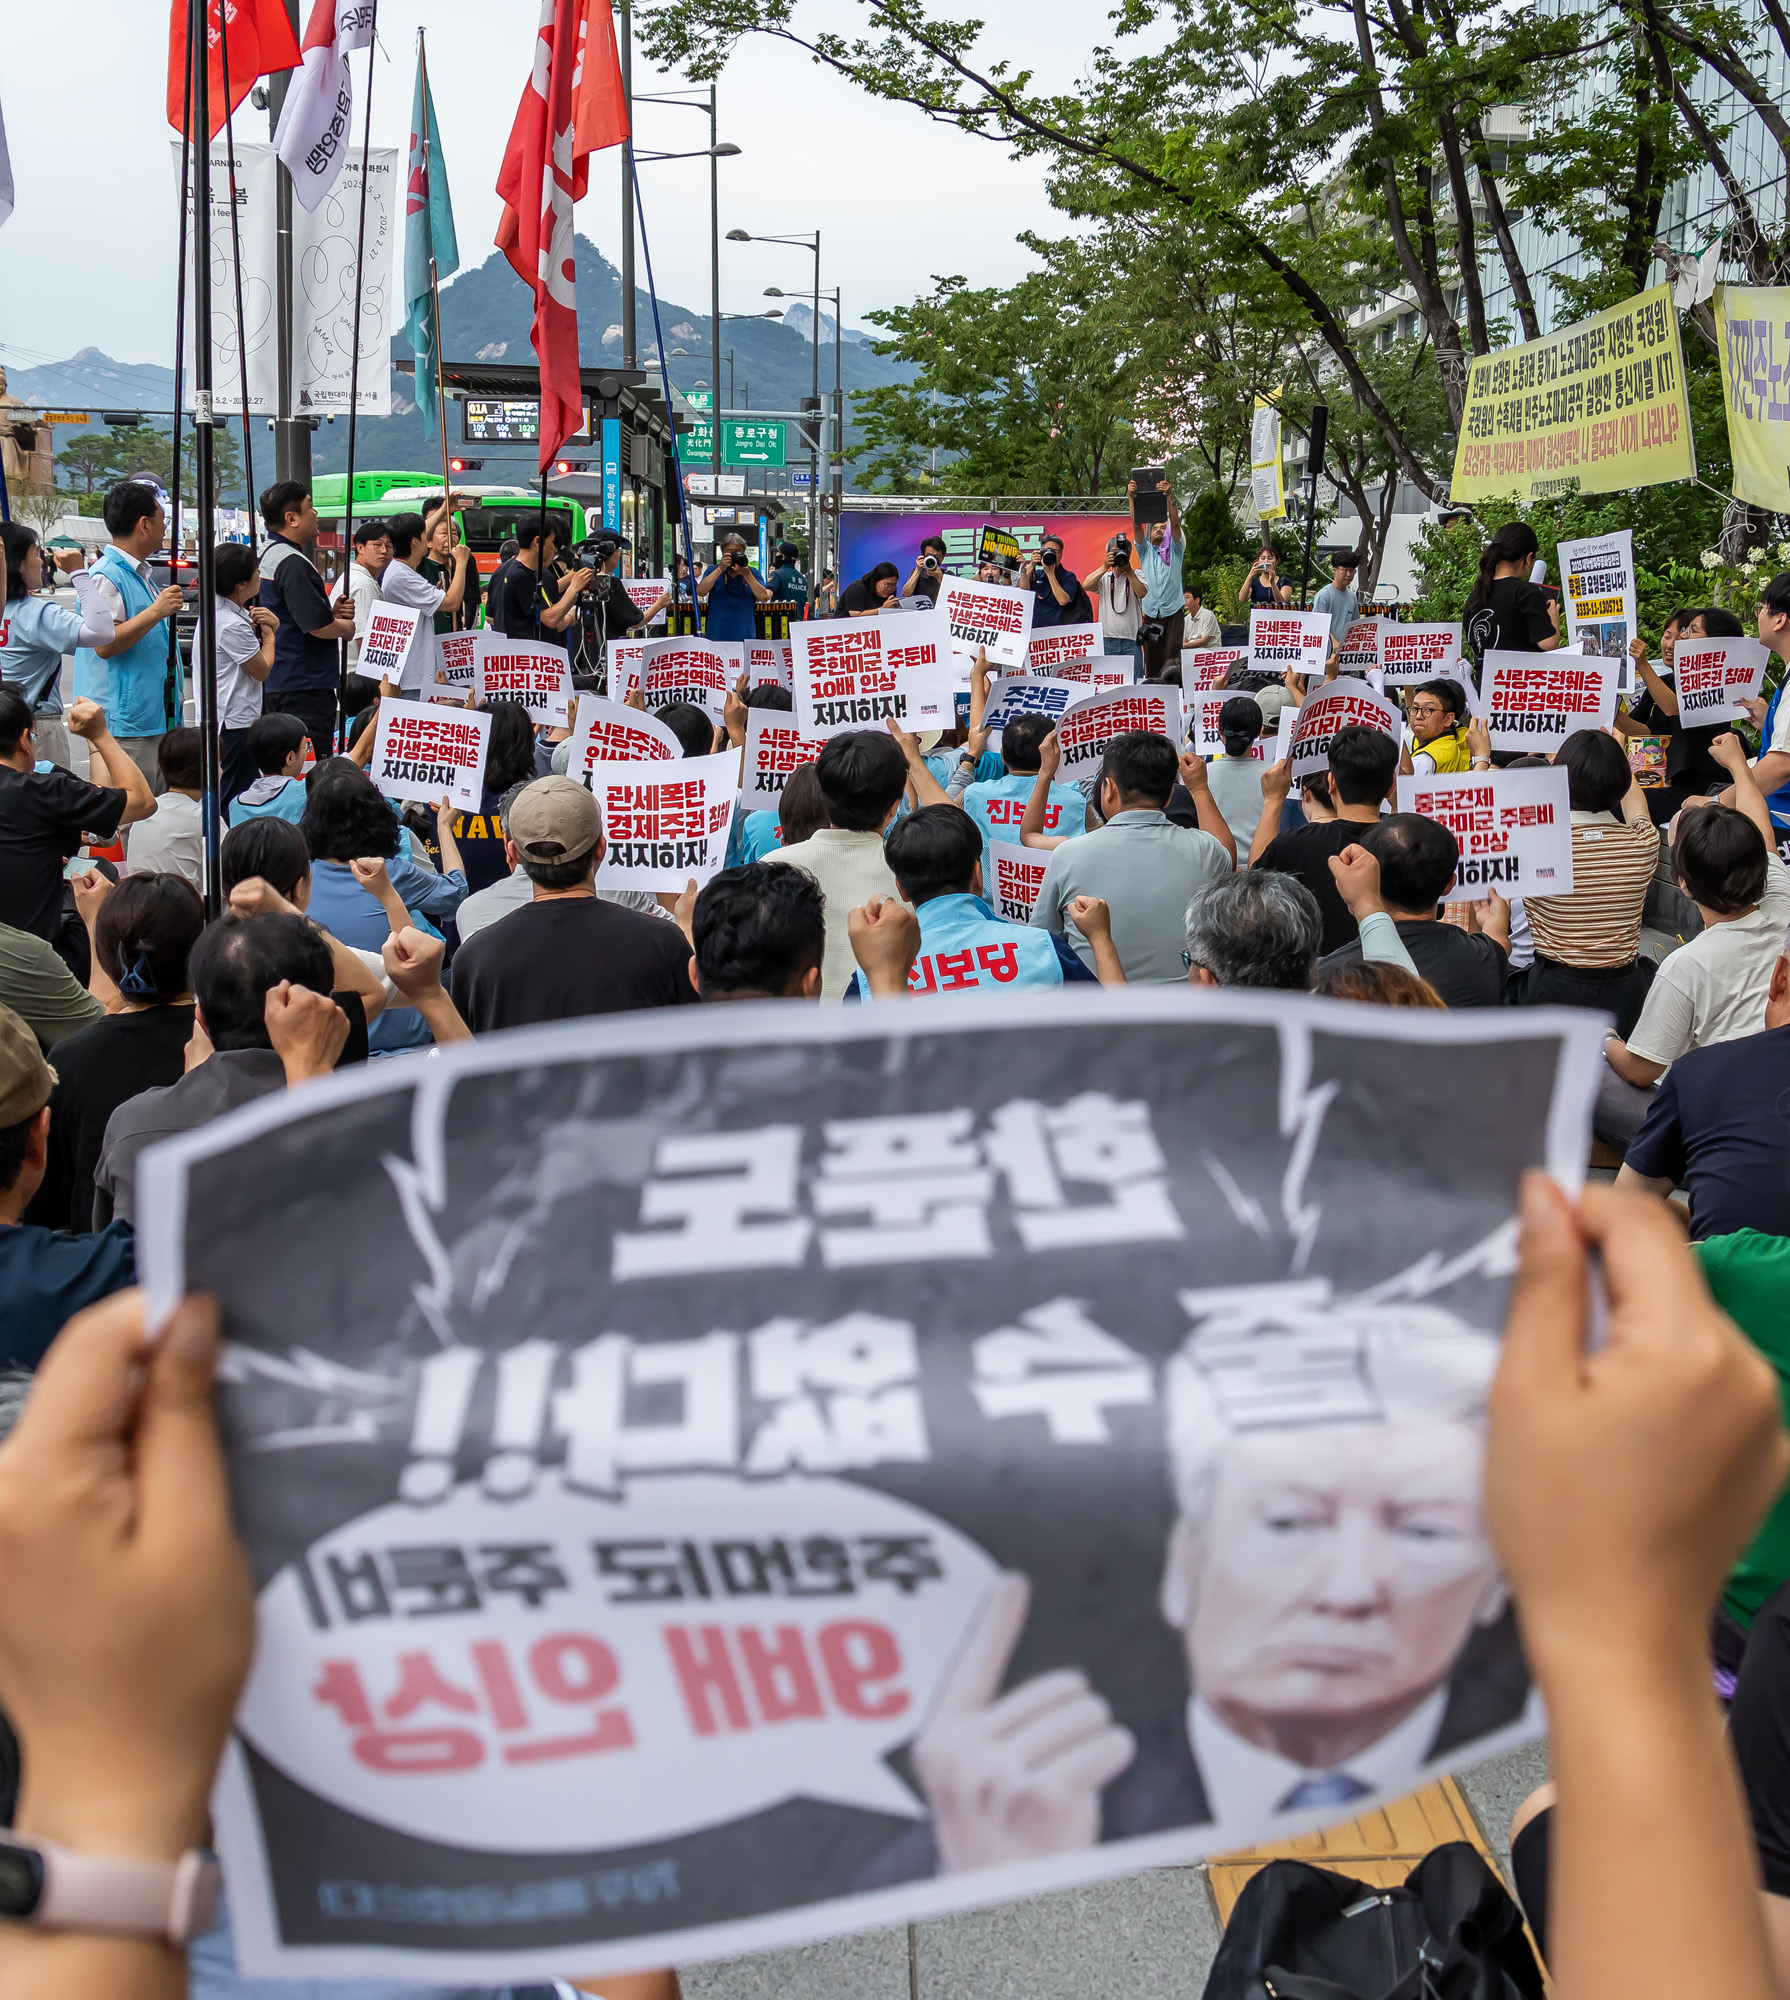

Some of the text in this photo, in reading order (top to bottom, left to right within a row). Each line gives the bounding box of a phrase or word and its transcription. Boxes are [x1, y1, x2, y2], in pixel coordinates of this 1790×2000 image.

[364, 165, 390, 174] 화전시
[313, 325, 334, 356] MMCA
[1473, 298, 1670, 398] 헌법에 보장된 노동3권 뭉개고 노조파괴공작 자행한 국정원!
[364, 392, 379, 400] 서울
[686, 394, 709, 406] 화문
[1467, 351, 1676, 439] 국정원의 수족처럼 민주노조파괴공작 실행한 통신재벌 KT!
[469, 403, 488, 415] 01A
[472, 424, 536, 433] 109 606 1020
[734, 426, 778, 440] 종로구청
[1592, 419, 1619, 463] 몰라라!
[1620, 411, 1639, 455] 이게
[1641, 402, 1680, 451] 나라냐?
[984, 531, 996, 541] NO
[982, 539, 1020, 558] NO KING
[788, 582, 807, 592] POLICE
[1568, 571, 1627, 598] 후원을 요청드립니다!
[947, 590, 1025, 617] 식량주권훼손
[371, 615, 415, 637] 대미투자강요
[950, 622, 999, 647] 지하자!
[1255, 620, 1303, 635] 관세폭탄
[368, 632, 396, 651] 일자리
[807, 629, 882, 657] 중국견제
[1028, 633, 1095, 654] 대미투자강요
[1254, 633, 1323, 648] 경제주권 침해
[1340, 642, 1360, 653] 10배
[1384, 633, 1454, 649] 대미투자강요
[363, 648, 399, 669] 저지하자!
[443, 646, 474, 660] 주한미
[445, 657, 467, 669] 10배
[648, 651, 725, 673] 식량주권훼손
[808, 651, 883, 678] 주한미군
[887, 644, 937, 669] 주둔비
[1030, 650, 1060, 668] 일자리
[1193, 650, 1241, 667] 트럼프이
[1253, 647, 1303, 661] 저지하자!
[1338, 653, 1378, 665] 저지하자
[1384, 647, 1445, 663] 일자리 강탈
[1679, 651, 1727, 674] 관세폭탄
[483, 655, 566, 676] 대미투자강요
[1383, 660, 1433, 676] 저지하자!
[484, 673, 561, 692] 일자리 강탈
[646, 669, 727, 692] 위생검역훼손
[810, 671, 897, 700] 10배 인상
[1093, 674, 1124, 685] 주둔비
[1494, 669, 1603, 693] 식량주권훼손
[1680, 667, 1754, 694] 경제주권 침해
[645, 688, 708, 709] 저지하자!
[813, 693, 908, 727] 저지하자!
[1002, 685, 1070, 713] 주권을
[1491, 691, 1601, 714] 위생검역훼손
[1682, 688, 1726, 712] 저지하자!
[1060, 697, 1166, 729] 식량주권훼손
[1302, 696, 1393, 732] 대미투자강요
[1488, 711, 1567, 735] 저지하자!
[389, 716, 482, 748] 식량주권훼손
[1060, 716, 1167, 748] 위생검역훼손
[1294, 716, 1342, 744] 일자리
[385, 739, 479, 769] 위생검역훼손
[381, 759, 456, 788] 저지하자!
[606, 779, 706, 812] 관세폭탄
[1414, 786, 1495, 814] 중국견제
[607, 799, 731, 841] 경제주권 침해
[1428, 802, 1554, 834] 한미군 주둔비
[608, 838, 708, 869] 저지하자!
[1470, 830, 1510, 855] 인상
[998, 858, 1047, 885] 관세폭
[999, 878, 1042, 905] 경제
